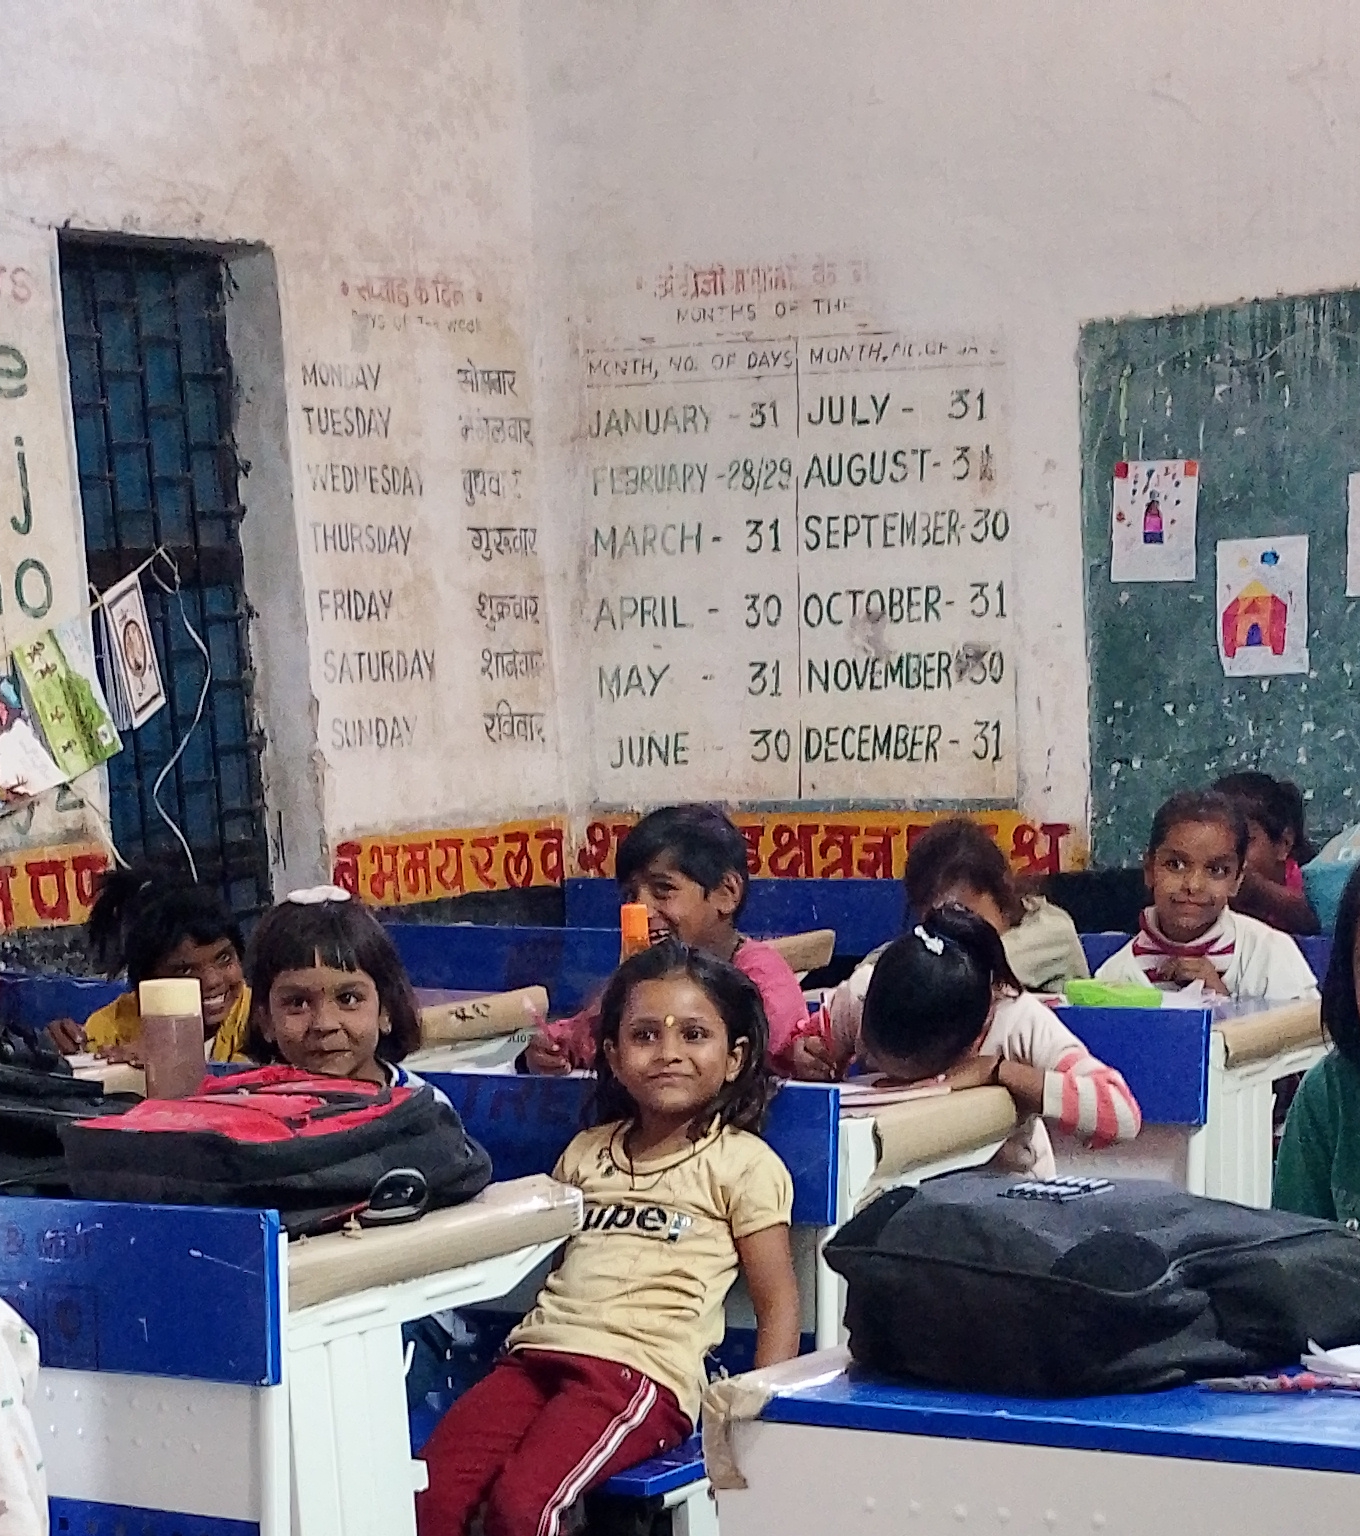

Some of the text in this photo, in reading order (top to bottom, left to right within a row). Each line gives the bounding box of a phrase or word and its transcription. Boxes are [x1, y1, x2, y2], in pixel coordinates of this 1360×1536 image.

[301, 363, 381, 391] MONDAY
[302, 405, 391, 439] TUESDAY
[588, 404, 712, 437] JANUARY
[807, 388, 987, 425] JULY 31
[11, 436, 32, 535] j
[310, 523, 412, 556] THURSDAY
[746, 517, 782, 553] 31
[14, 559, 53, 619] o
[318, 589, 393, 622] FRIDAY
[971, 581, 1007, 619] 31
[594, 593, 782, 631] APRIL 30
[324, 649, 436, 683] SATURDAY
[598, 661, 782, 701] MAY 31
[331, 715, 417, 749] SUNDAY
[610, 728, 789, 768] JUNE 30
[805, 719, 1003, 763] DECEMBER 31
